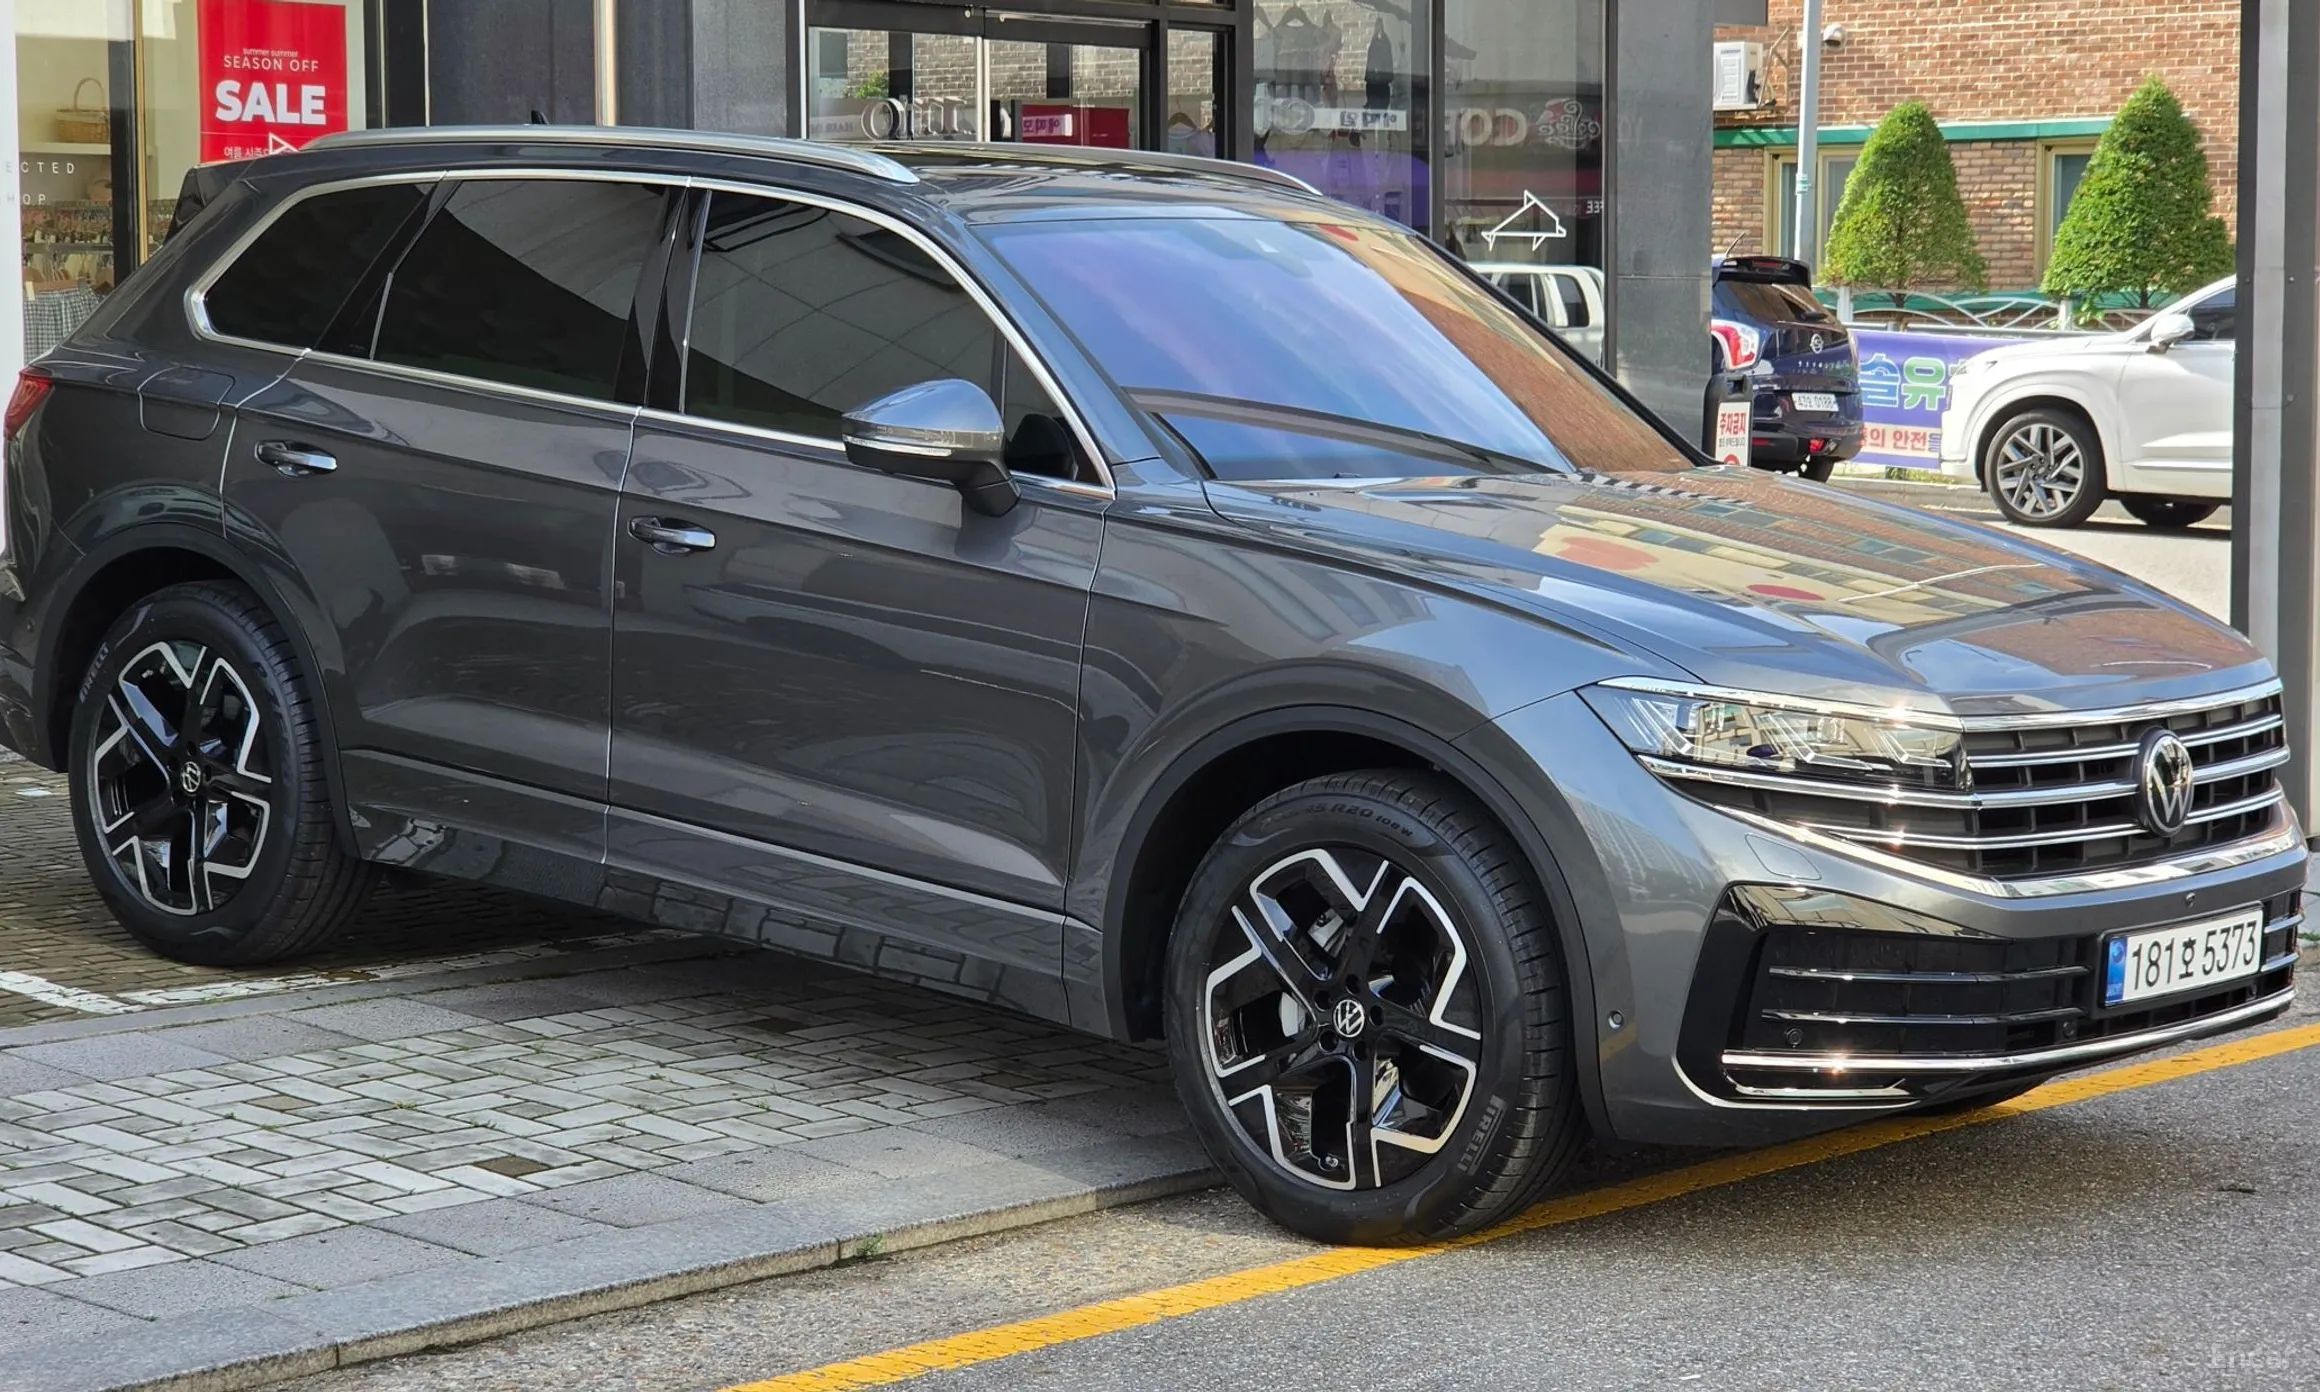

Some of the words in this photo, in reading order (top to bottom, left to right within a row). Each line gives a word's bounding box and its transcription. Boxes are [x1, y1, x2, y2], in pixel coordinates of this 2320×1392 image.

[223, 55, 283, 71] SEASON
[289, 59, 319, 72] OFF
[215, 79, 327, 125] SALE
[1719, 412, 1747, 436] 주차금지
[2131, 936, 2197, 991] 181호
[2201, 919, 2258, 976] 5373
[1457, 1094, 1507, 1176] PIRELLI
